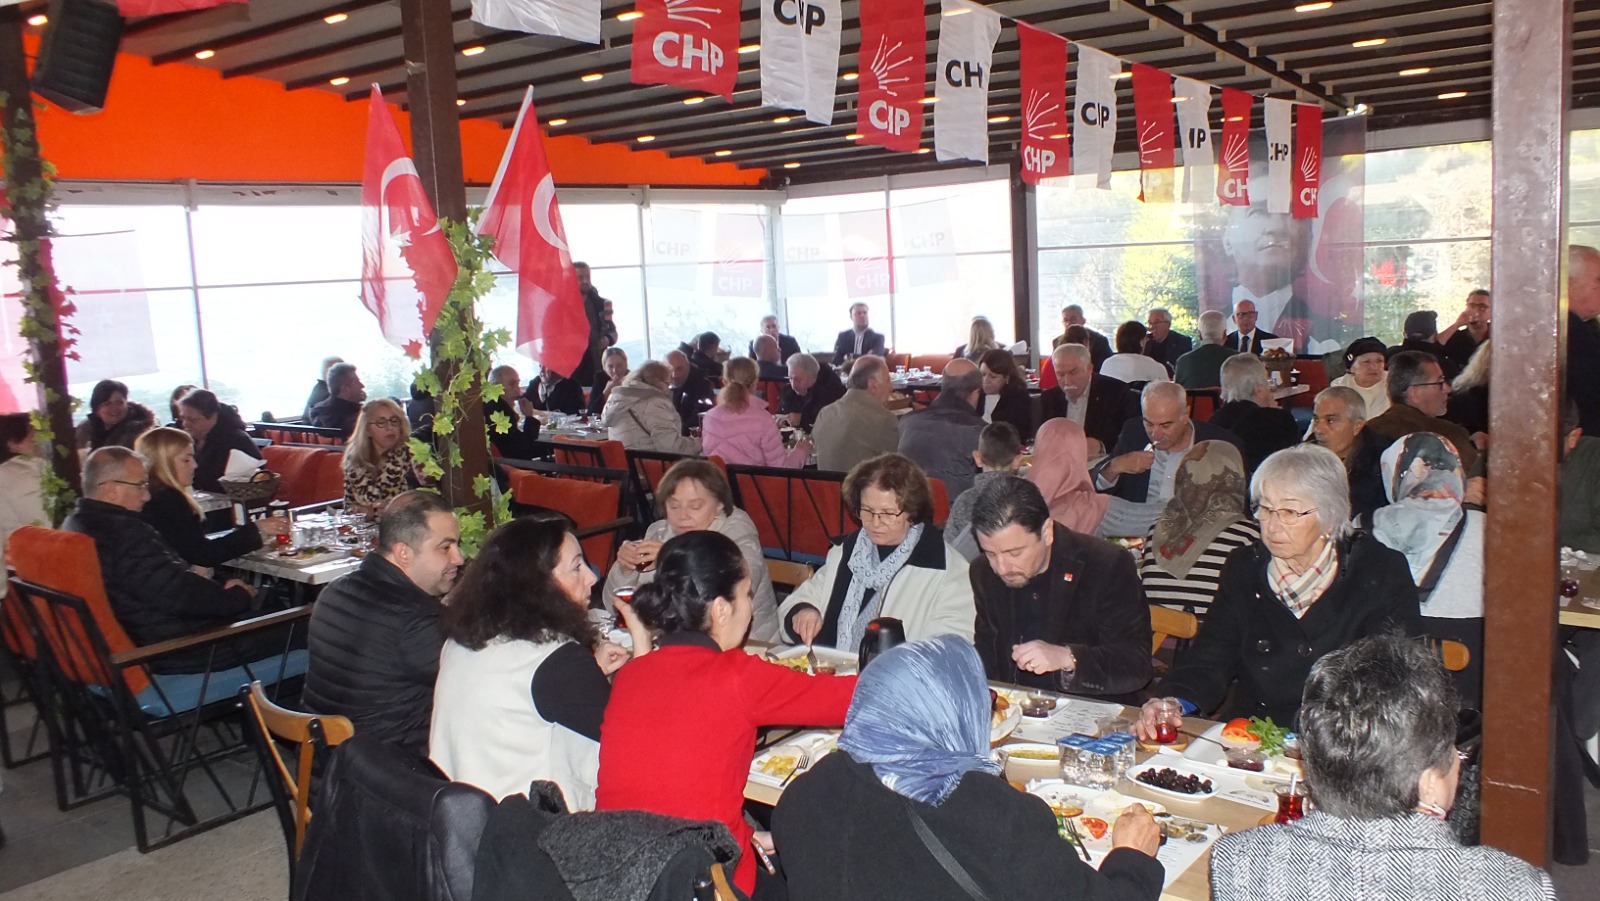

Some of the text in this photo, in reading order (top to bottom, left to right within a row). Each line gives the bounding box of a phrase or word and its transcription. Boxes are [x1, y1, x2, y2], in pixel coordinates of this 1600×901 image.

[652, 30, 724, 76] CHP
[945, 59, 983, 88] CH
[1081, 102, 1110, 128] CP
[1023, 145, 1056, 174] CHP
[655, 241, 690, 256] CHP
[911, 232, 944, 249] CHP
[718, 276, 752, 290] CHP
